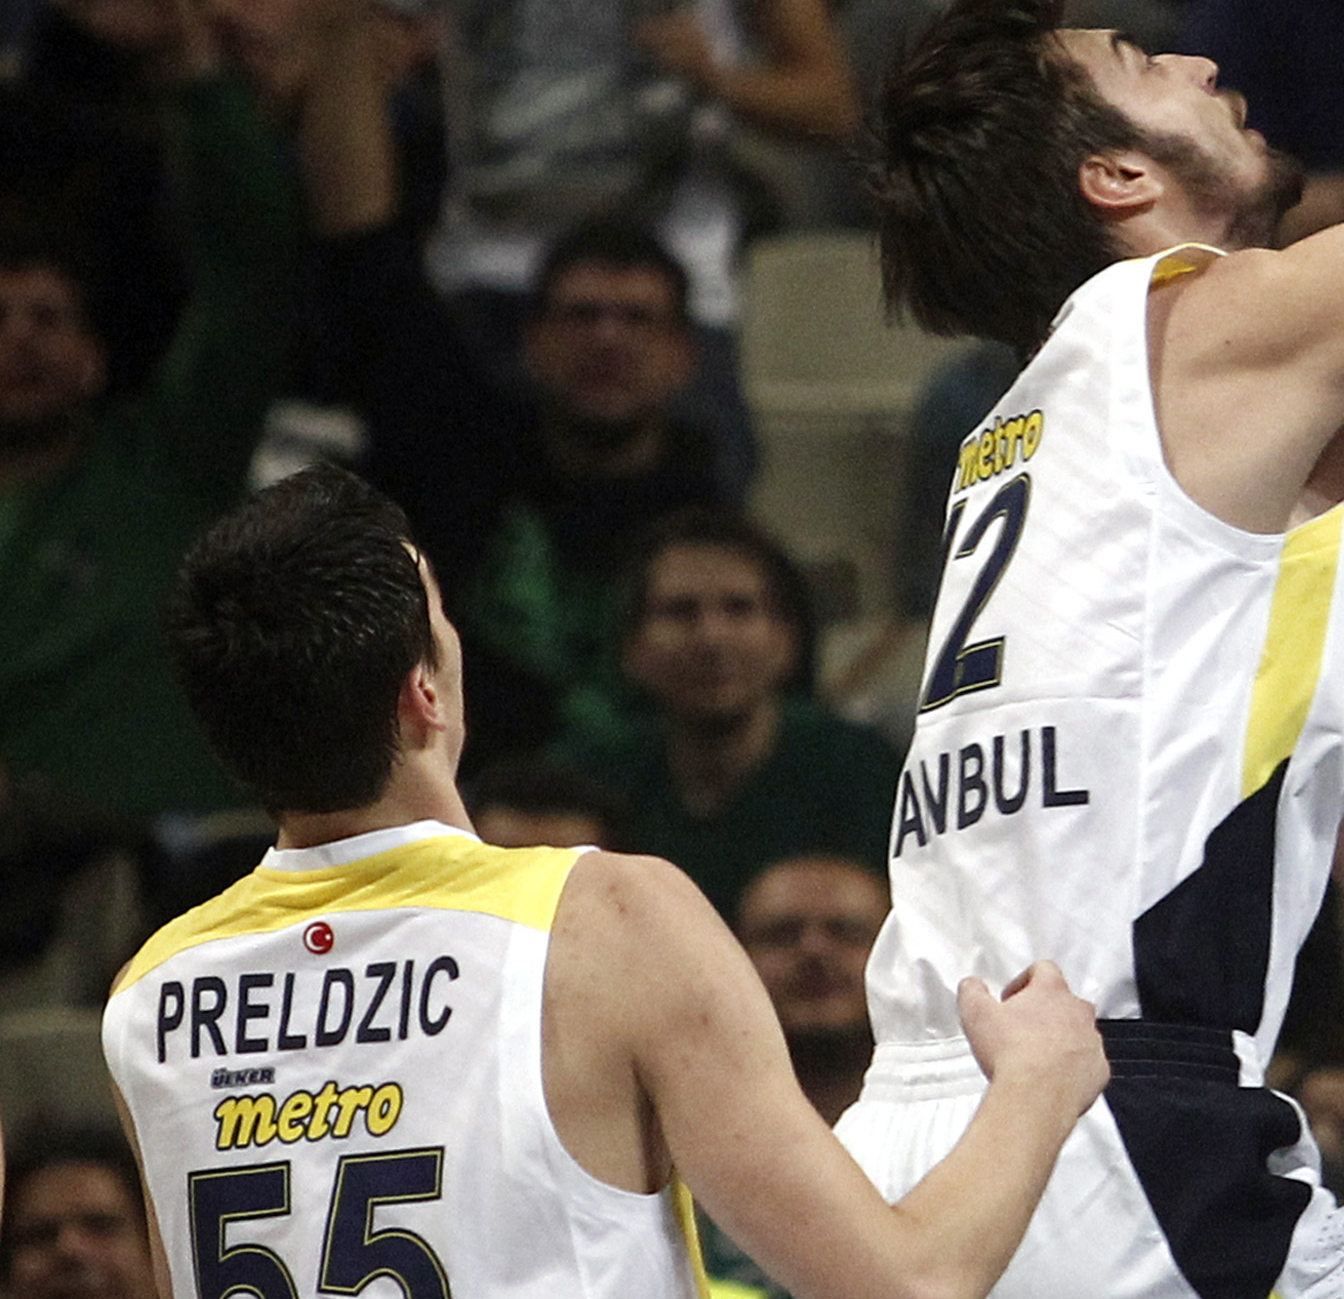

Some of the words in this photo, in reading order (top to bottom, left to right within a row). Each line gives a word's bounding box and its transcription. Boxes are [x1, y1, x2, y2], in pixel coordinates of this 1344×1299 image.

[953, 408, 1044, 494] metro
[156, 954, 461, 1065] PRELDZIC
[213, 1080, 404, 1152] metro
[187, 1145, 455, 1299] 55
